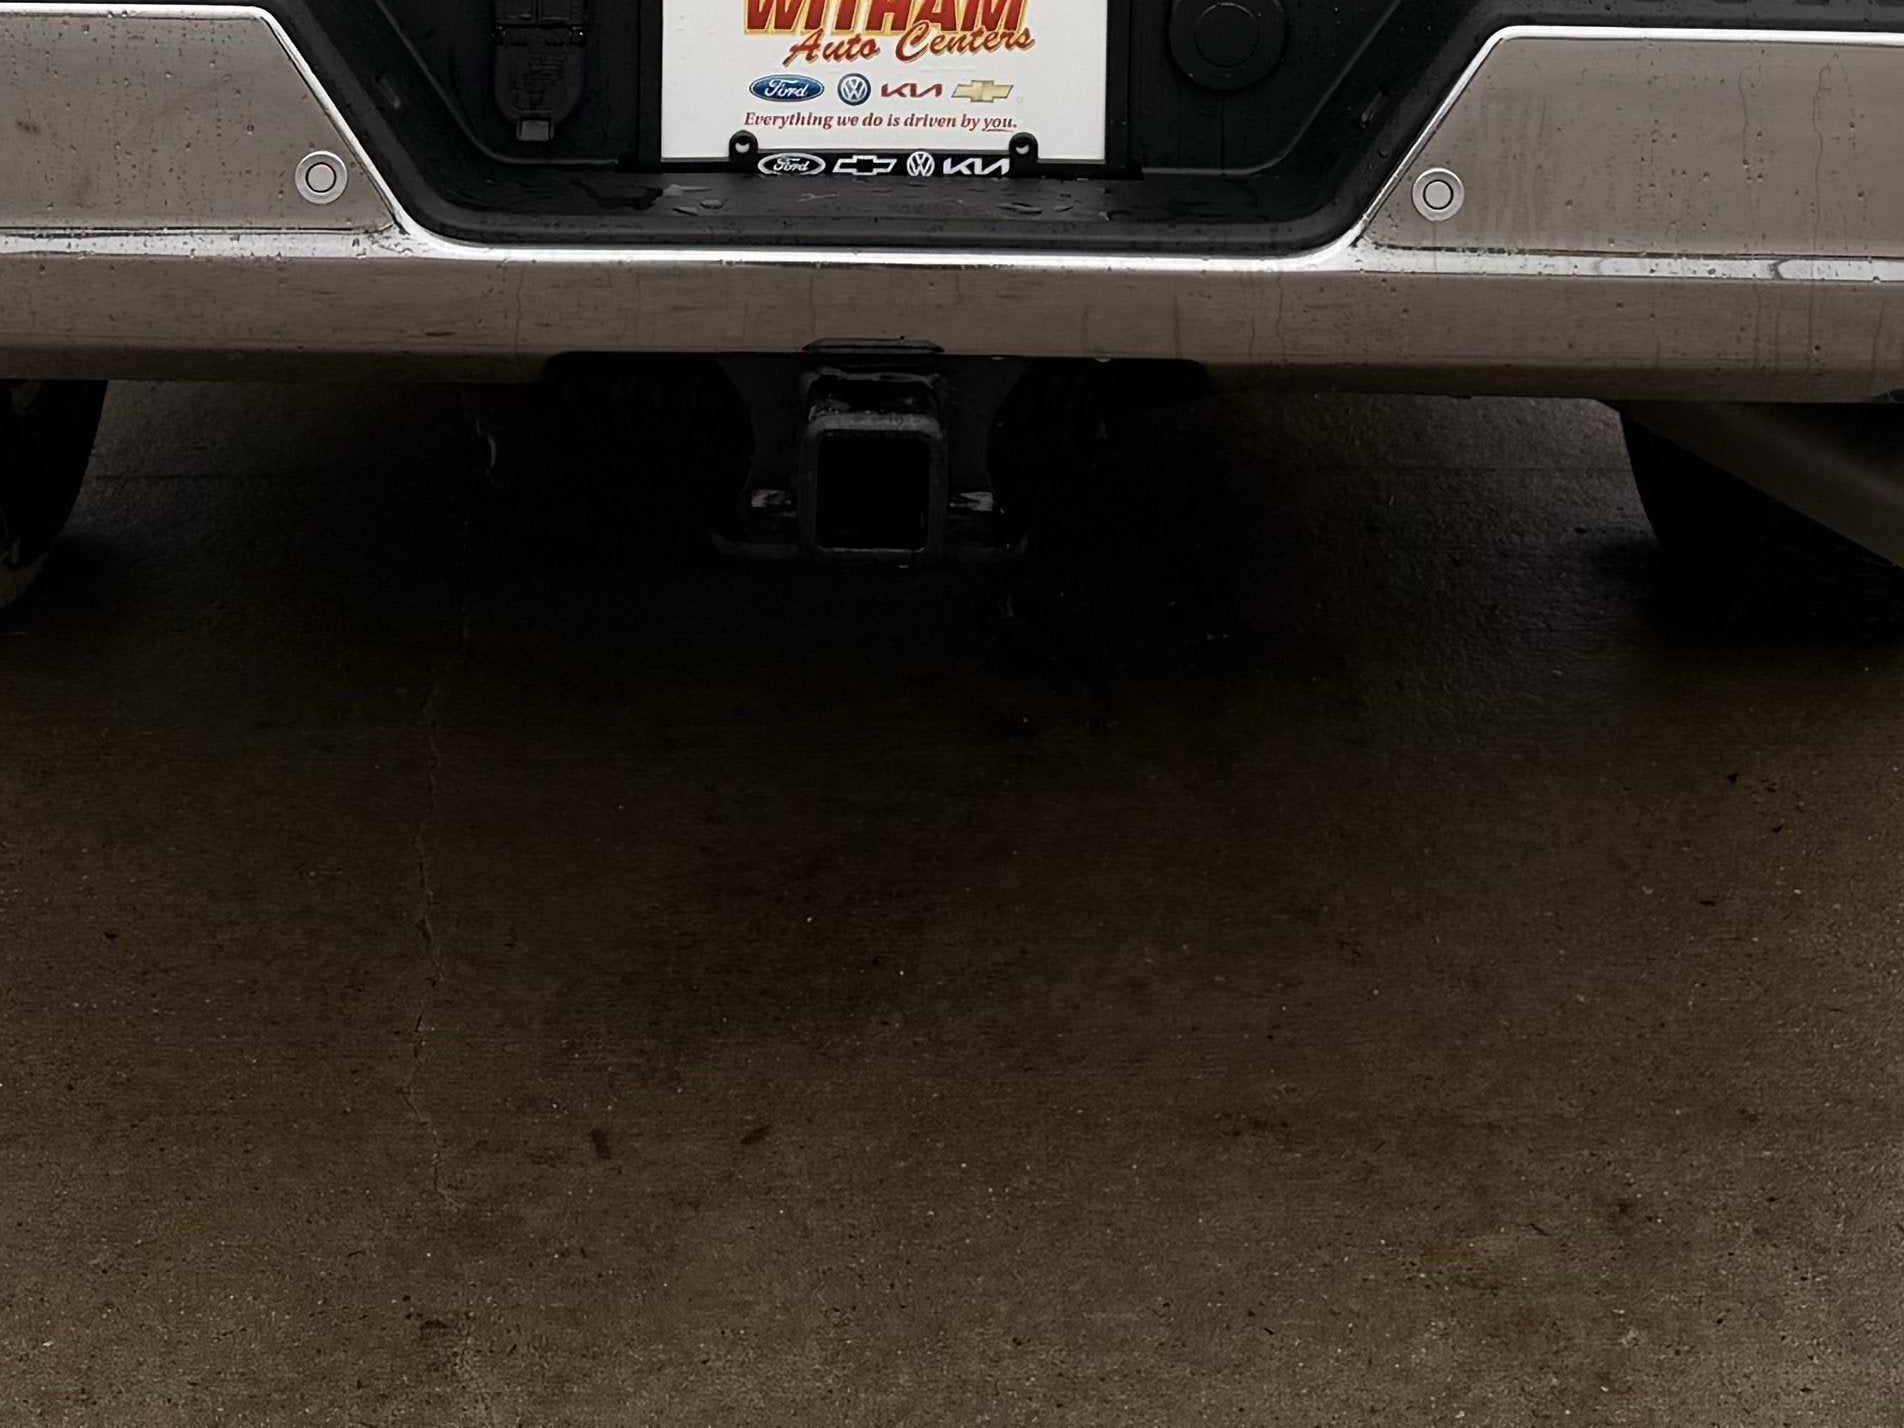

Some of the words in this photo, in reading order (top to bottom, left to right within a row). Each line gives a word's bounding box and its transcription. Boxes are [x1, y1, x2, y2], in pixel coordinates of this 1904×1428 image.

[782, 27, 881, 68] Auto
[895, 20, 1036, 63] Centers
[744, 111, 834, 130] Everything
[836, 115, 859, 127] we
[862, 112, 883, 127] do
[887, 113, 901, 127] is
[903, 113, 957, 128] driven
[960, 114, 981, 132] by
[982, 117, 1018, 132] you.
